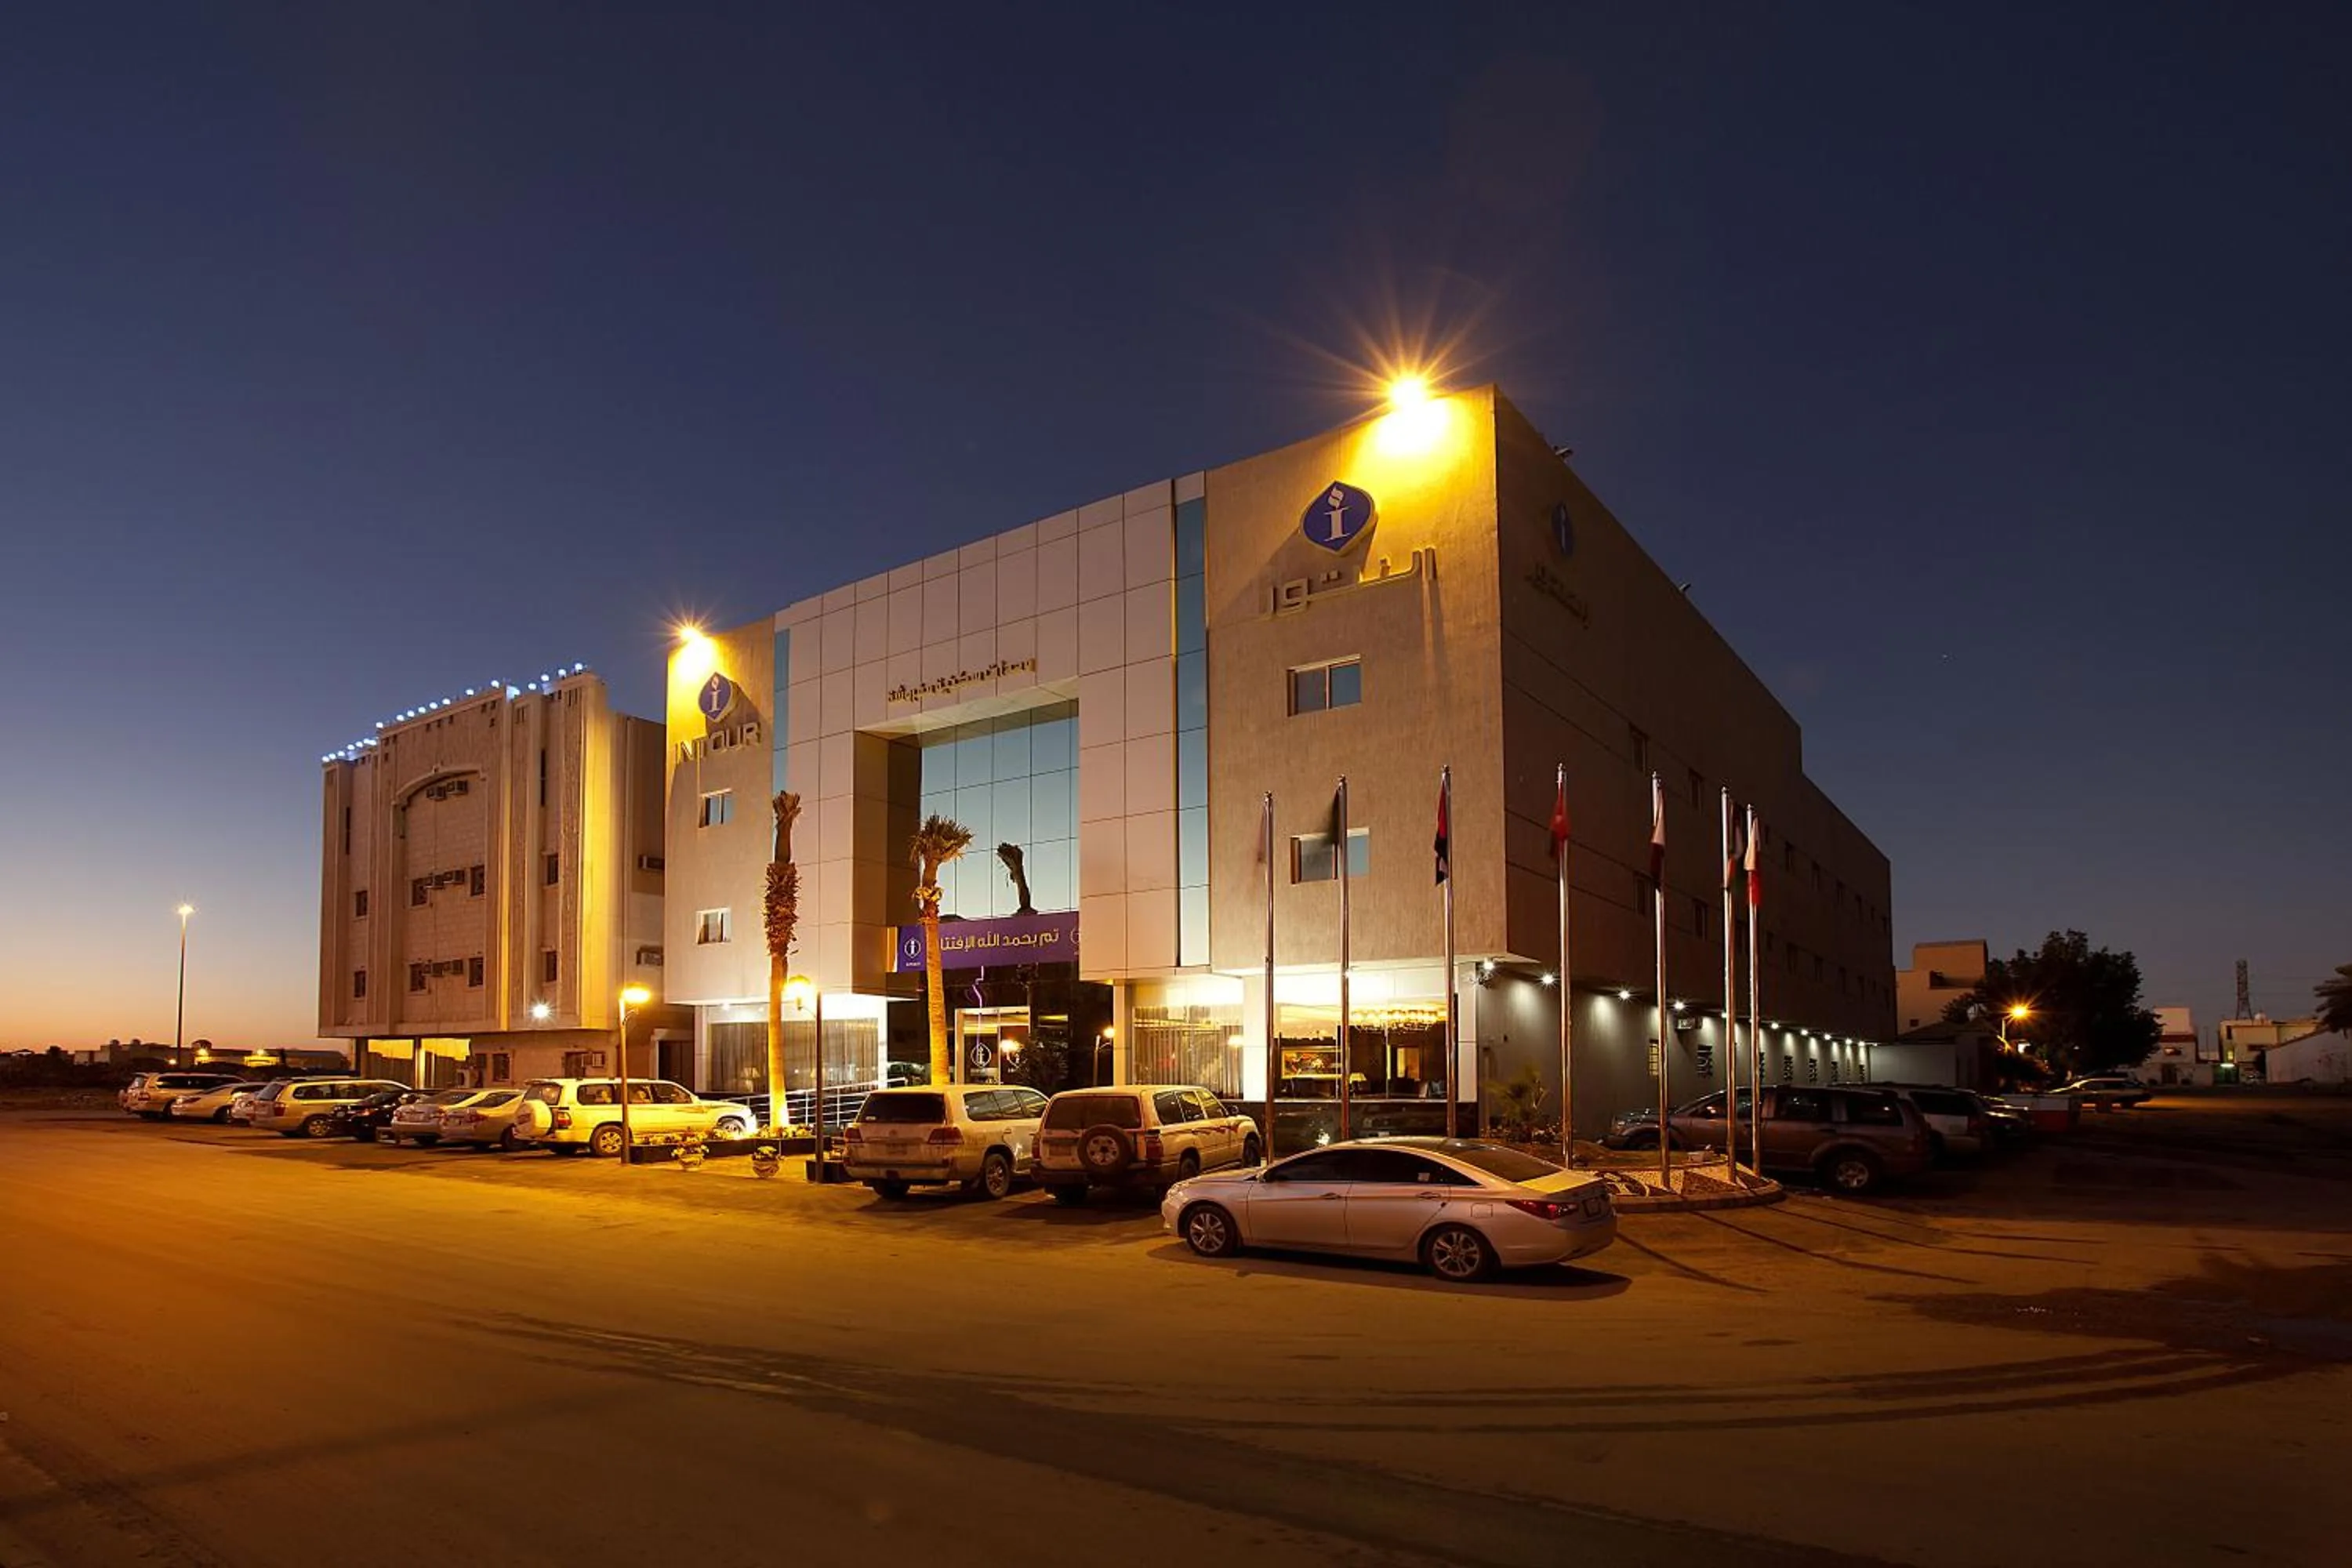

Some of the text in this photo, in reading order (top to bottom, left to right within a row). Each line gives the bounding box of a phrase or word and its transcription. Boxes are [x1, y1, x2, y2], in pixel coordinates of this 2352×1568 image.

[941, 928, 1059, 953] تم بحمد الله الإفتتا
